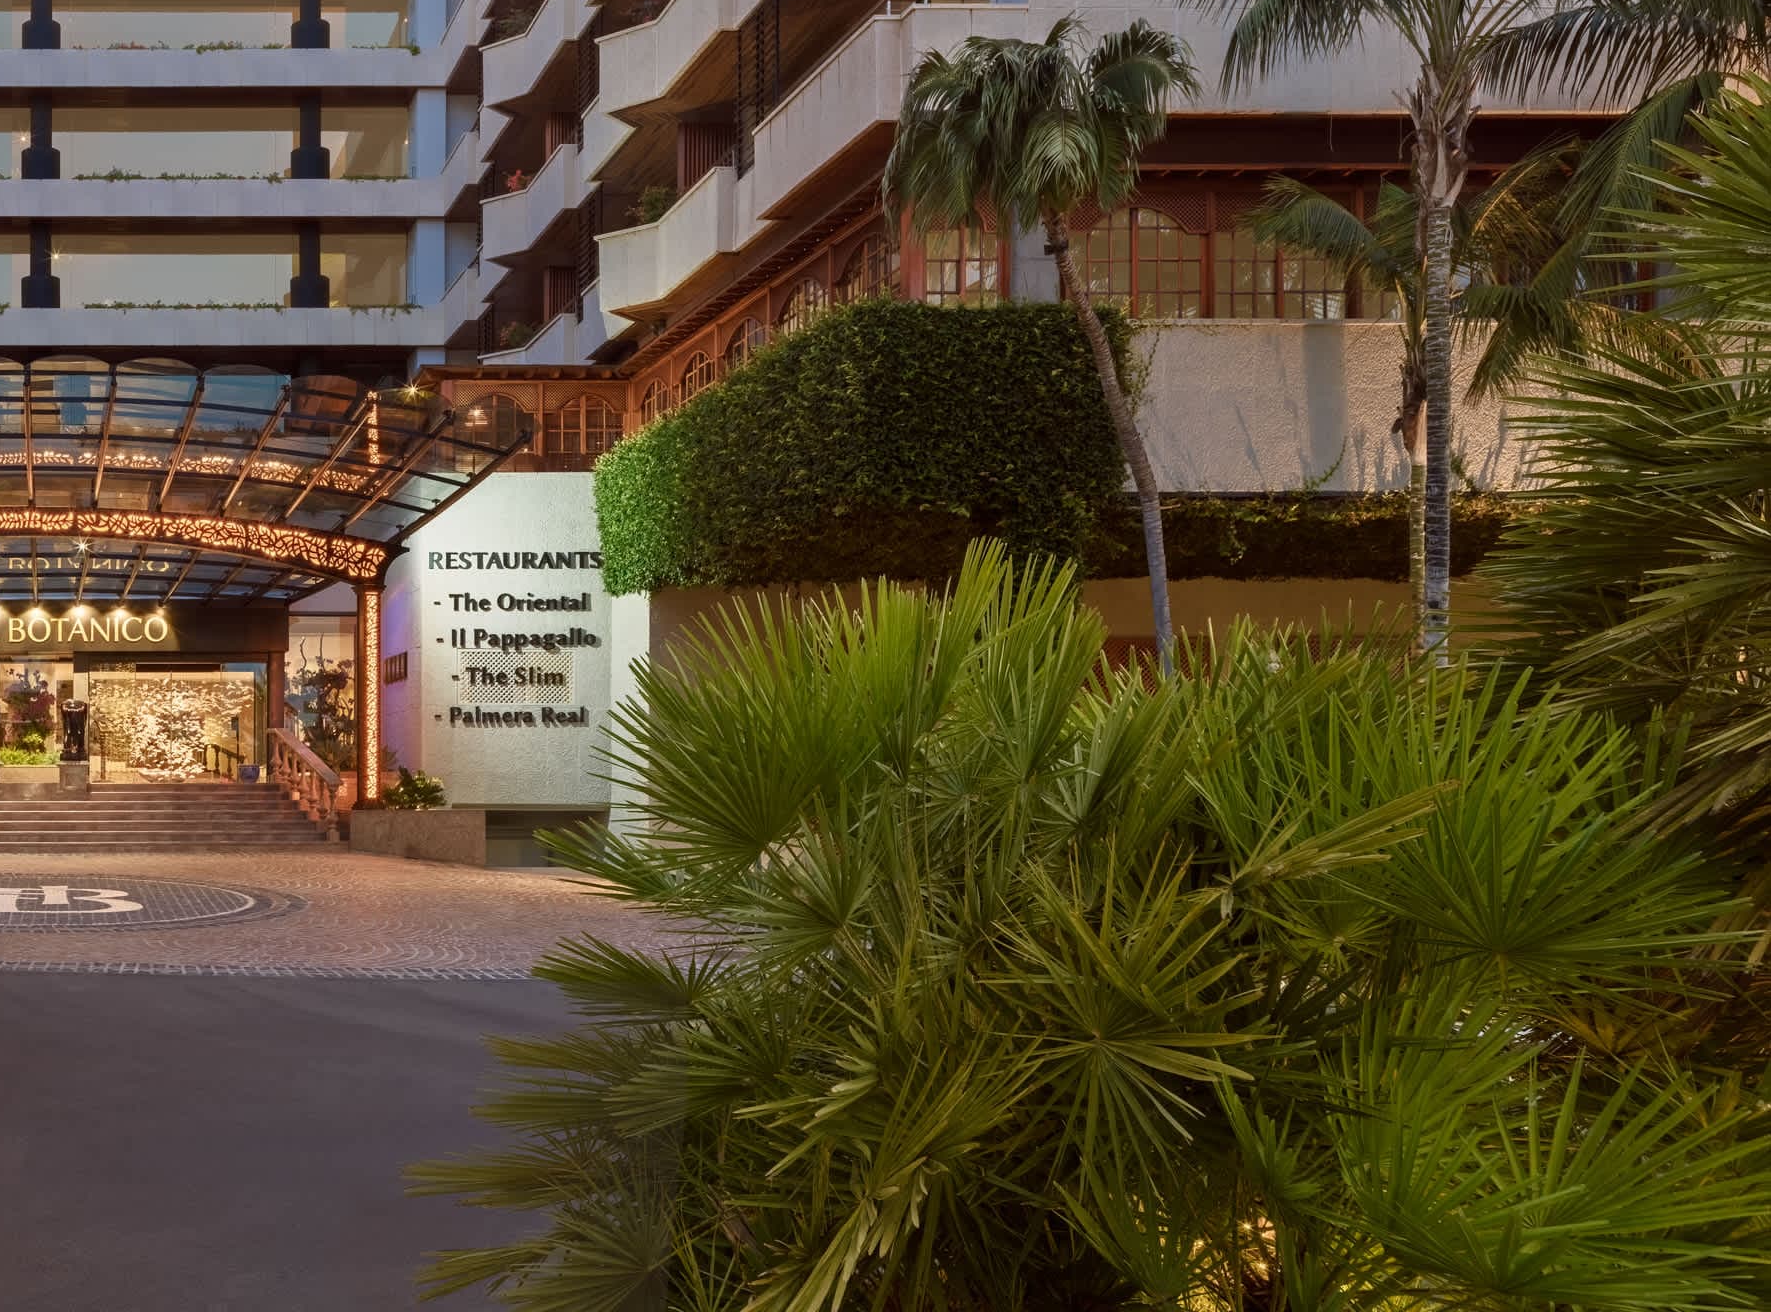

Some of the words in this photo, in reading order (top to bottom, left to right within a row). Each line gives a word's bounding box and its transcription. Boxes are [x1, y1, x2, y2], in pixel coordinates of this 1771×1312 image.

[427, 551, 605, 570] RESTAURANTS
[448, 592, 493, 612] The
[496, 592, 592, 613] Oriental
[473, 627, 601, 655] Pappagallo
[465, 666, 510, 687] The
[513, 666, 566, 687] Slim
[449, 706, 537, 728] Palmera
[541, 706, 590, 728] Real
